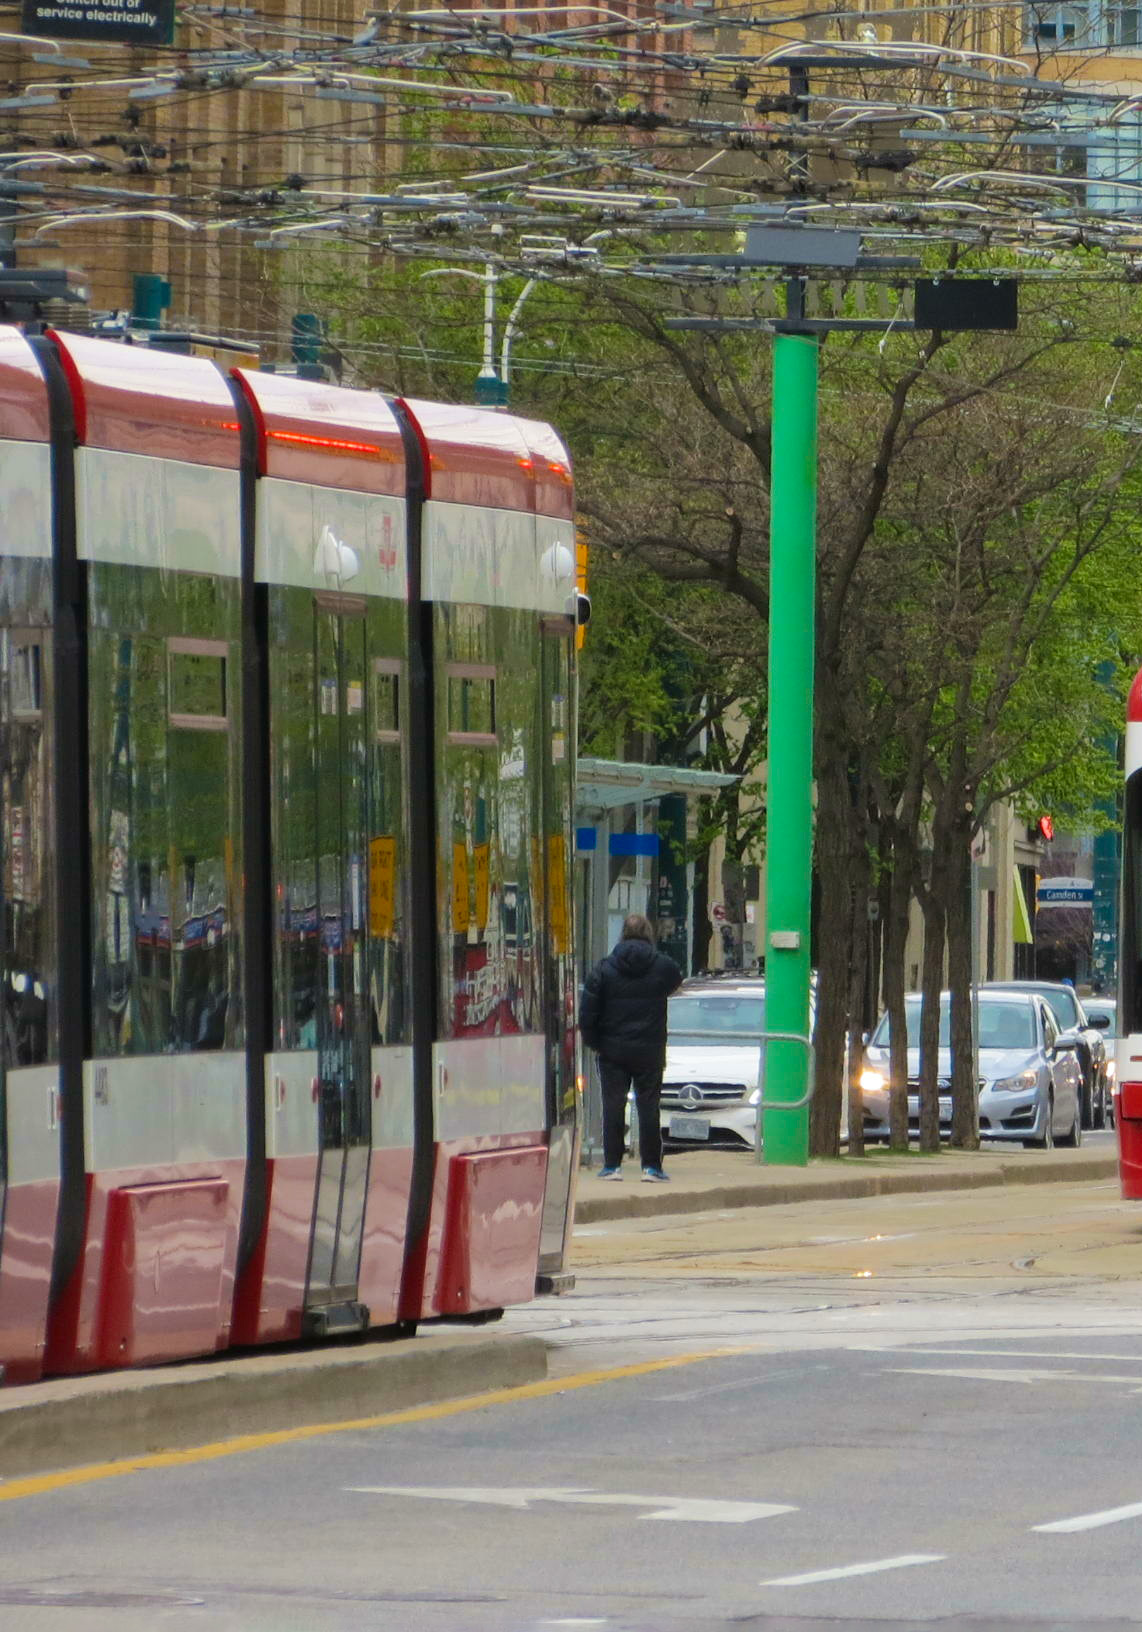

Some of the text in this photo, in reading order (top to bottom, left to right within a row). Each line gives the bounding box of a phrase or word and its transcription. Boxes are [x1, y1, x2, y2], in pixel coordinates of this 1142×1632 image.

[36, 7, 157, 26] service electrically
[1046, 889, 1077, 900] Camden
